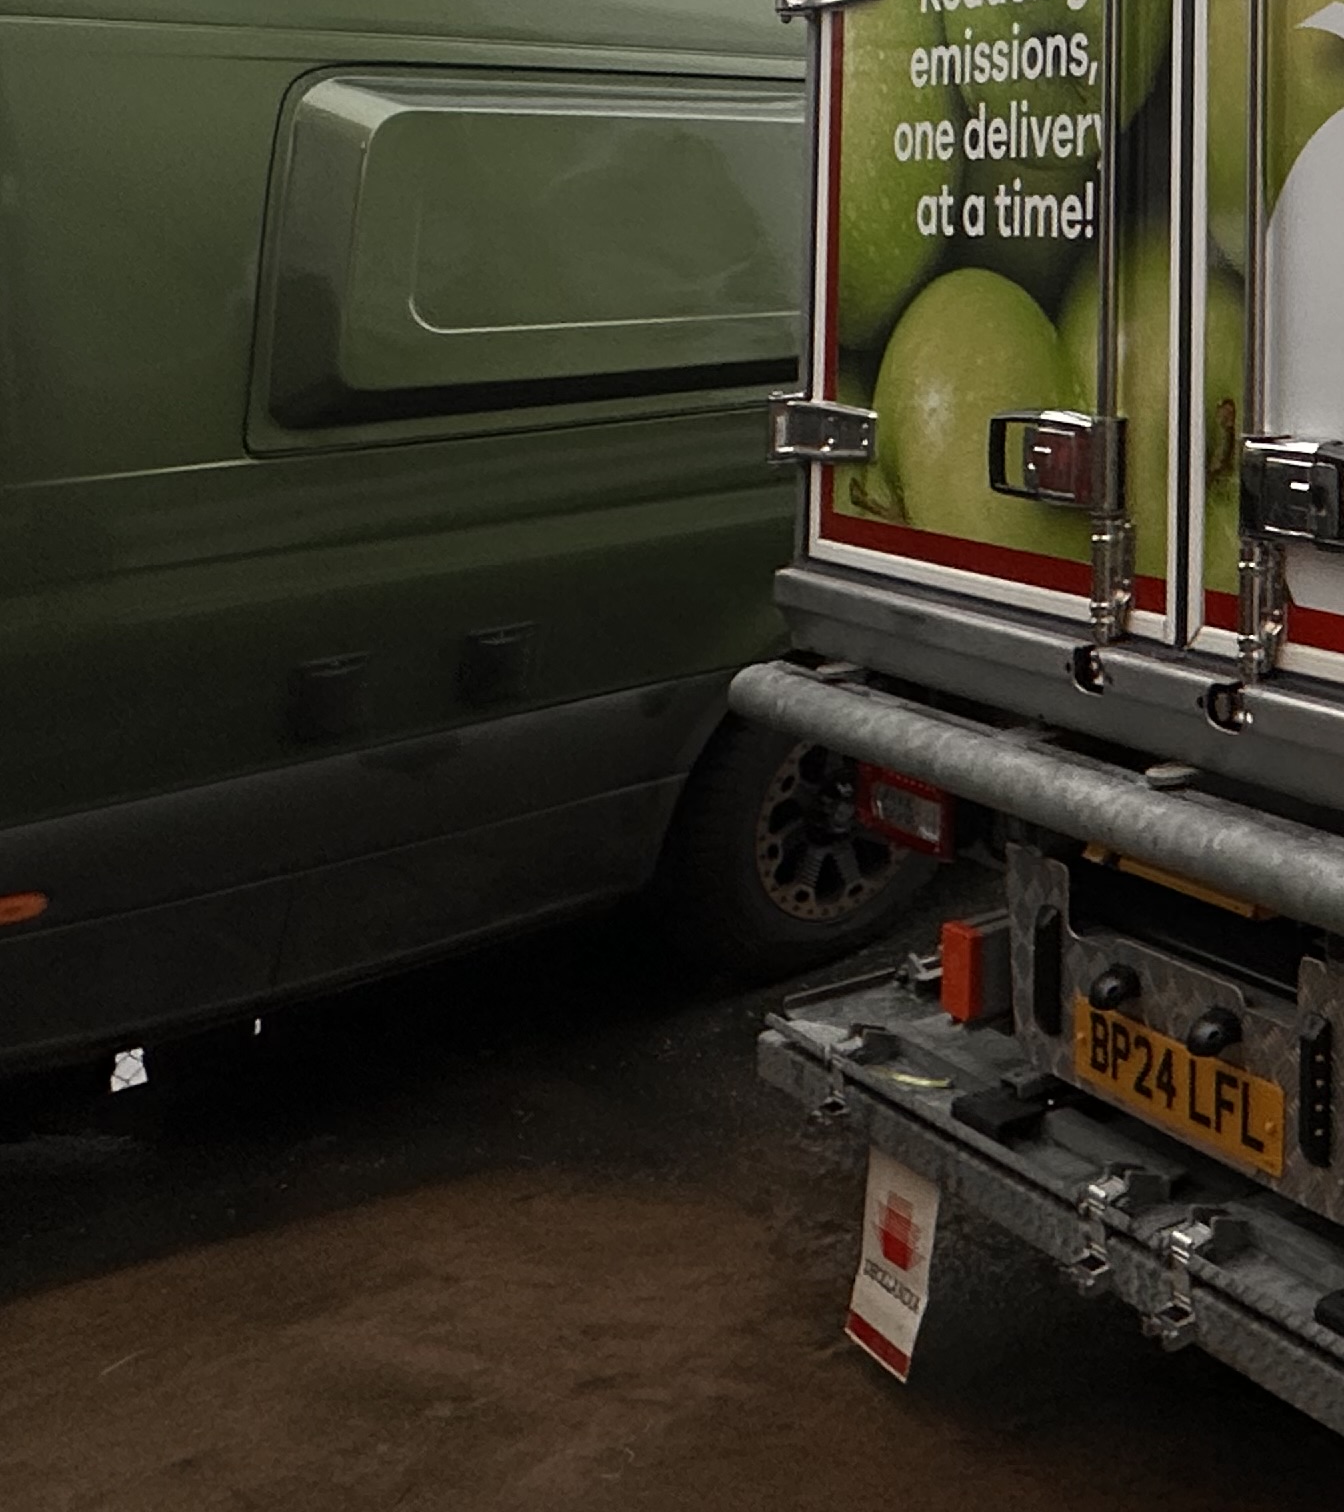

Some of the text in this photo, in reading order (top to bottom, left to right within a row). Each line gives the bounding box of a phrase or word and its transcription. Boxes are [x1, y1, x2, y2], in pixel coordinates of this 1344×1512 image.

[910, 22, 1097, 87] emissions,
[894, 119, 955, 161] one
[916, 177, 1094, 239] at a time!
[1089, 1012, 1264, 1153] BP24 LFL
